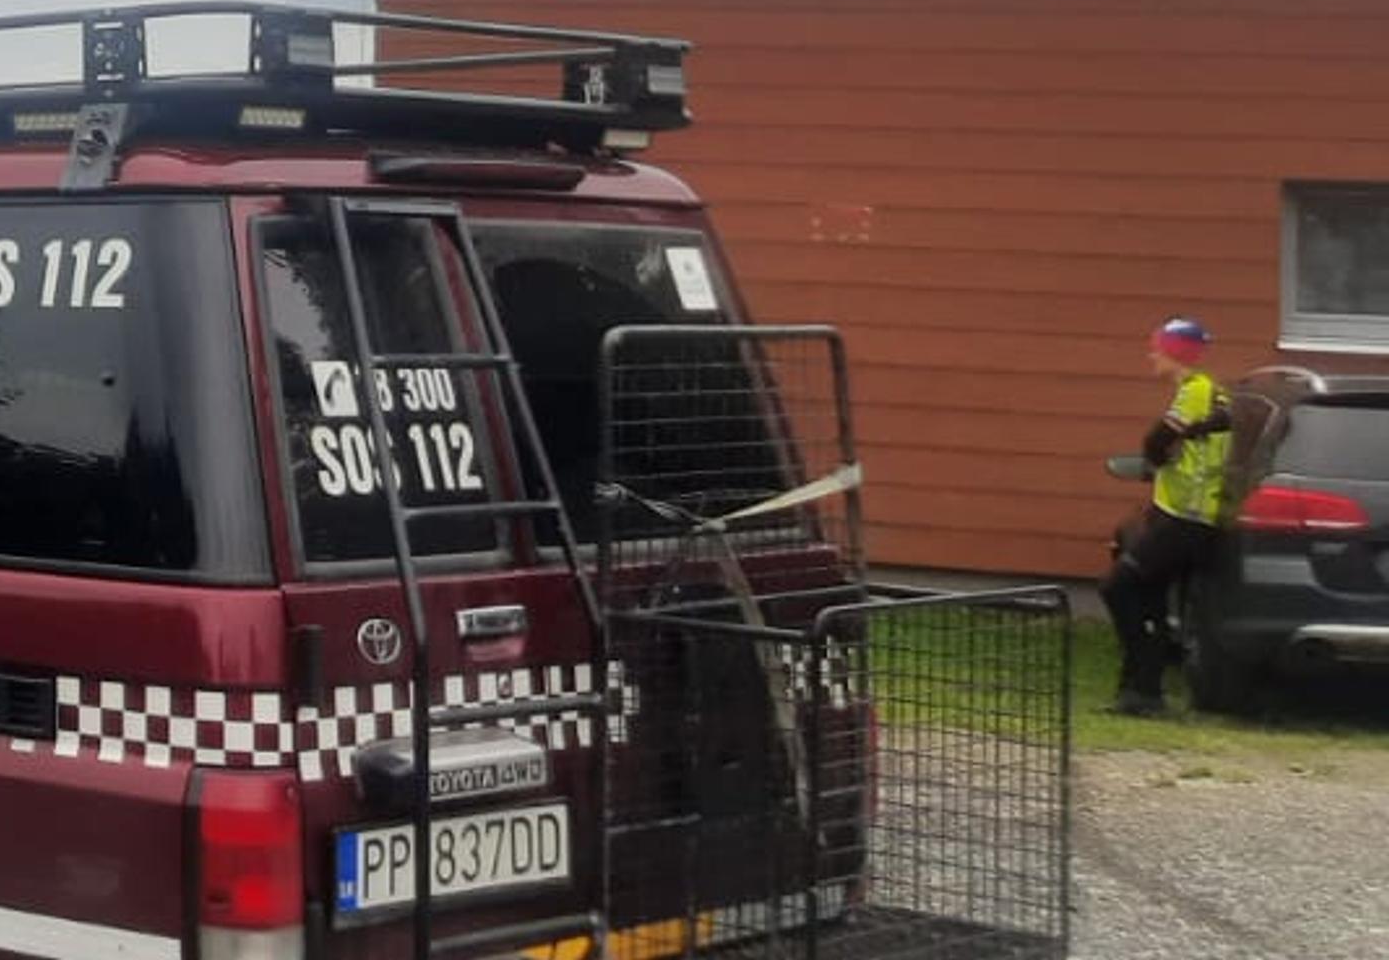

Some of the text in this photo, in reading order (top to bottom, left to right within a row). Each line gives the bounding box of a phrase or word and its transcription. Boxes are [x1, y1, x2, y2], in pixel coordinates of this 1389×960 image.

[41, 239, 132, 307] 112
[397, 368, 456, 411] 300
[409, 422, 483, 490] 112
[363, 812, 560, 899] PP 837DD
